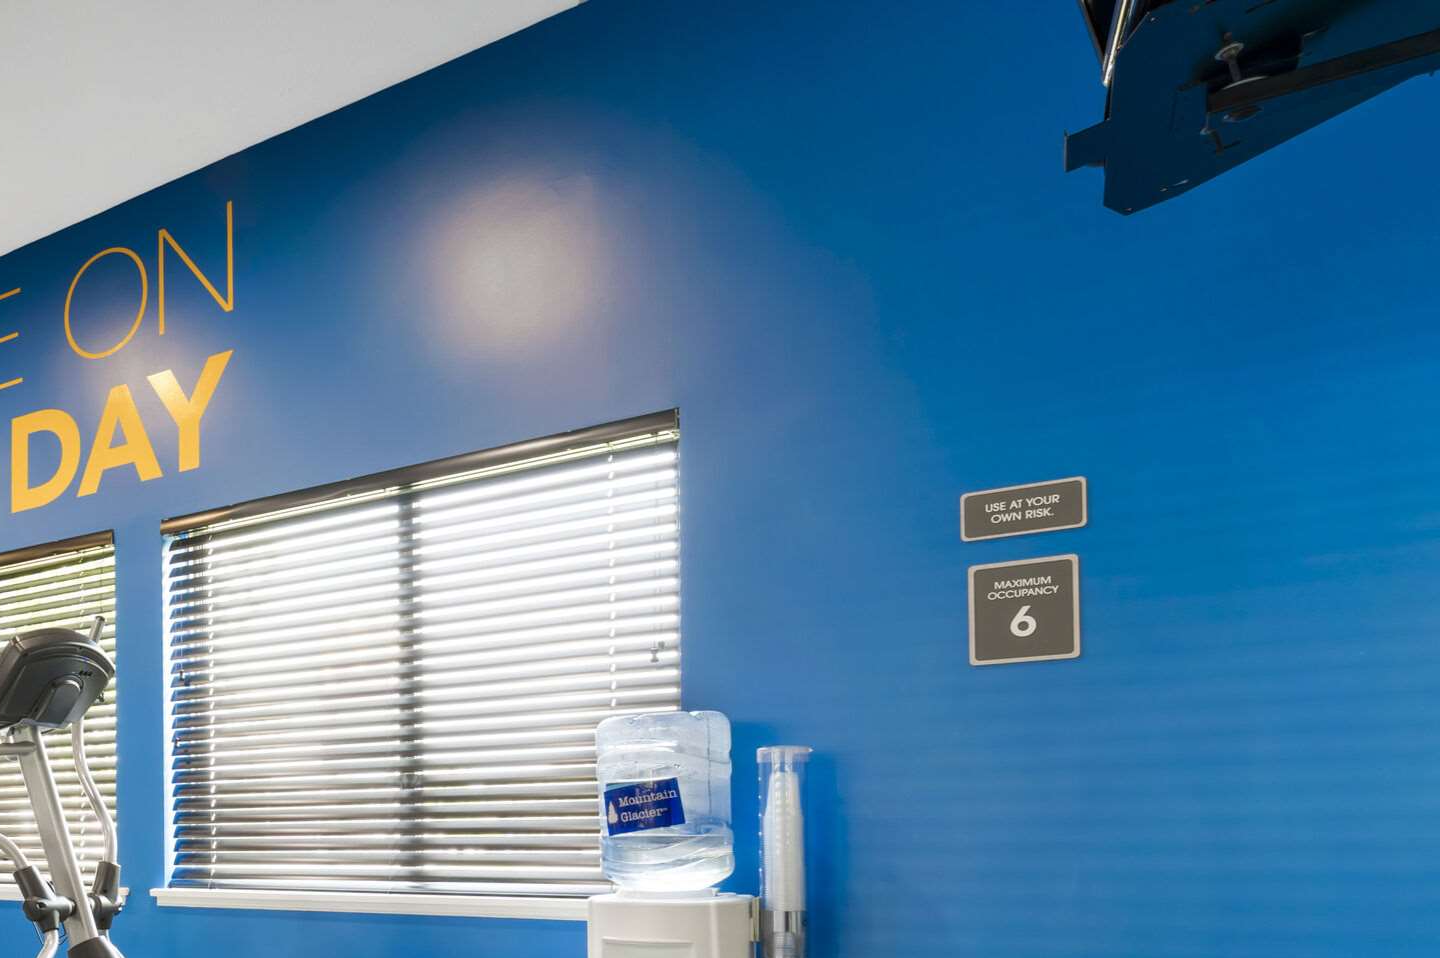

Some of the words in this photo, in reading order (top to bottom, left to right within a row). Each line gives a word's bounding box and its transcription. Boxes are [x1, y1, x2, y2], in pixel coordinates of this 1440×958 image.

[63, 199, 234, 360] ON
[10, 349, 234, 514] DAY
[985, 501, 1007, 513] USE
[1009, 499, 1023, 510] AT
[1025, 494, 1060, 507] YOUR
[990, 511, 1022, 524] OWN
[1024, 507, 1055, 519] RISK.
[993, 575, 1052, 590] MAXIMUM
[987, 585, 1060, 601] OCCUPANCY
[1009, 604, 1038, 637] 6
[618, 789, 678, 807] Mountain
